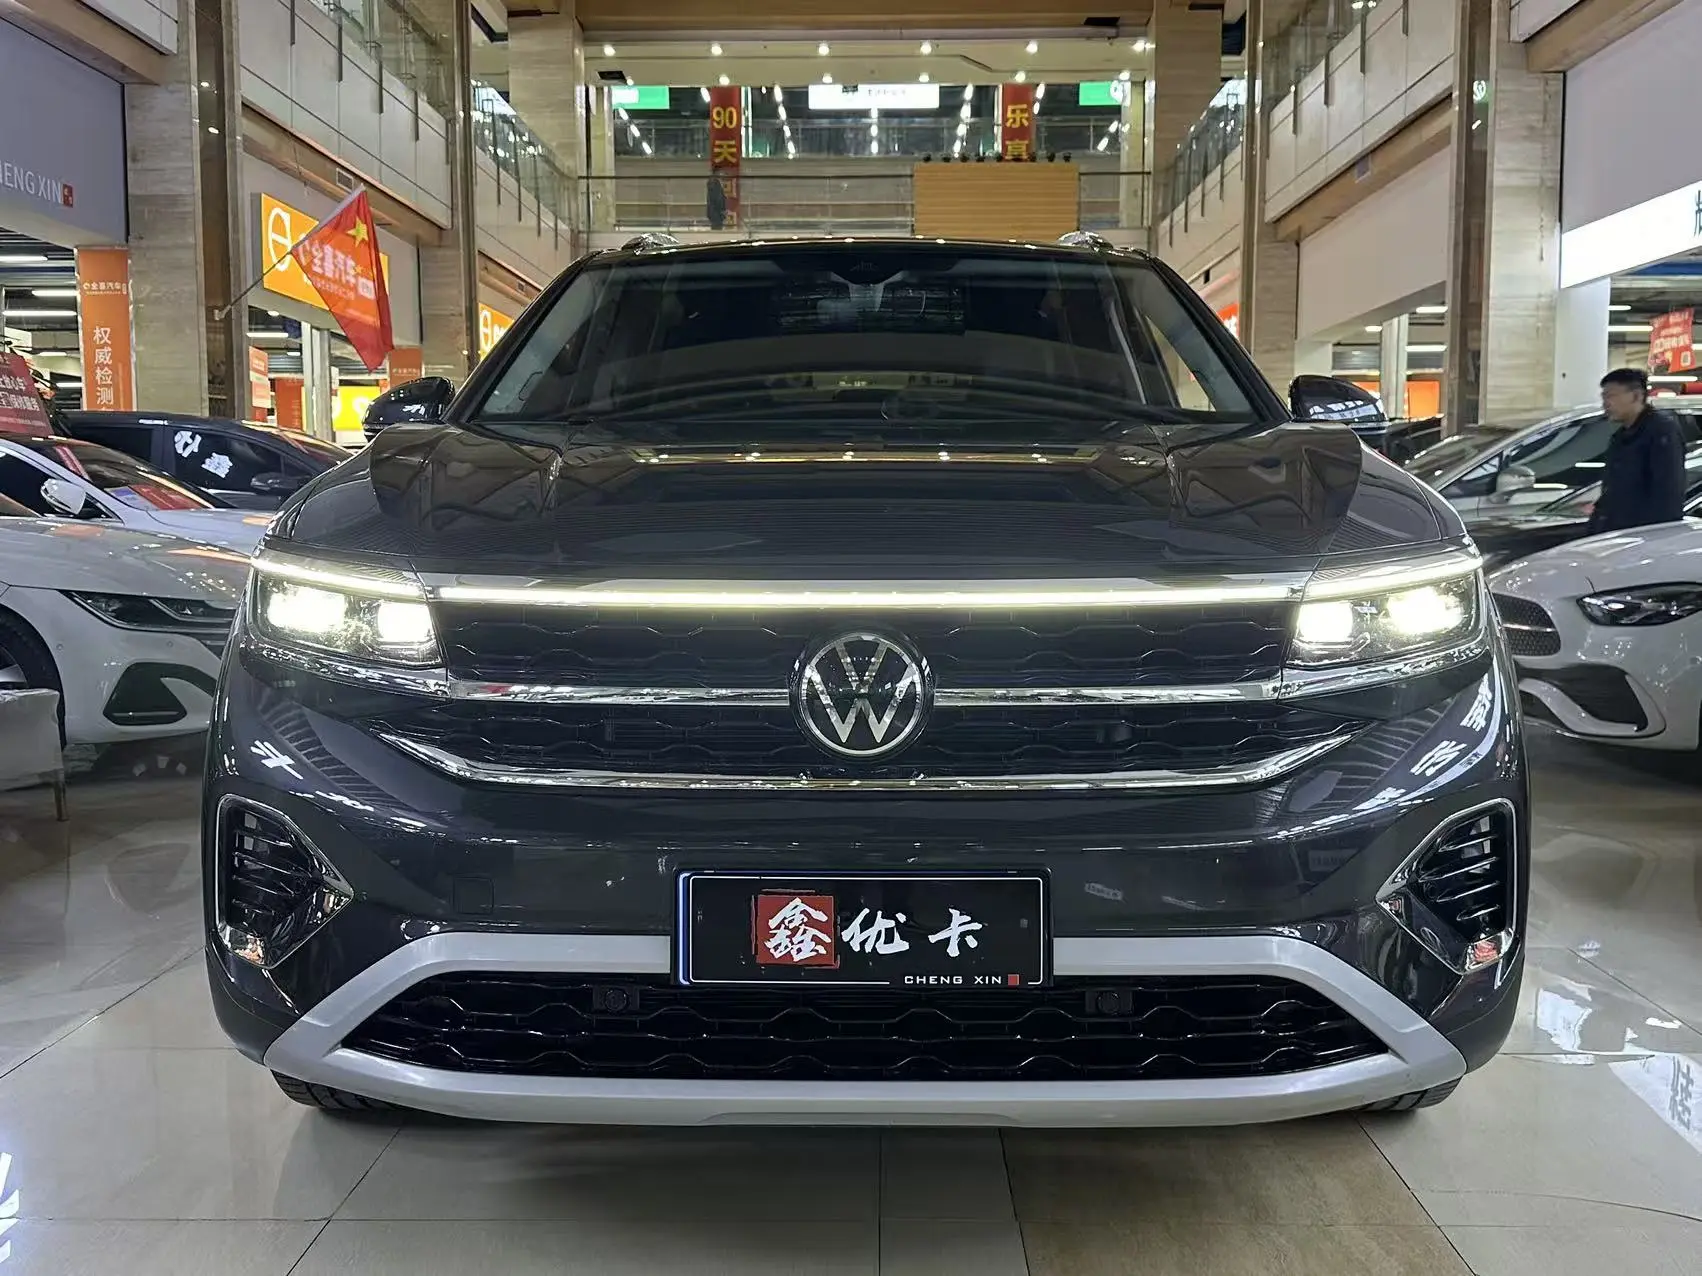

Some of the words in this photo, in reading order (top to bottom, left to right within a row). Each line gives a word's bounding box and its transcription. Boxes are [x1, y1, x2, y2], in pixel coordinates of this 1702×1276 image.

[0, 160, 36, 195] ENG
[38, 175, 63, 204] XIN
[93, 326, 114, 410] 权威检测
[903, 974, 963, 985] CHENG
[974, 974, 1002, 985] XIN
